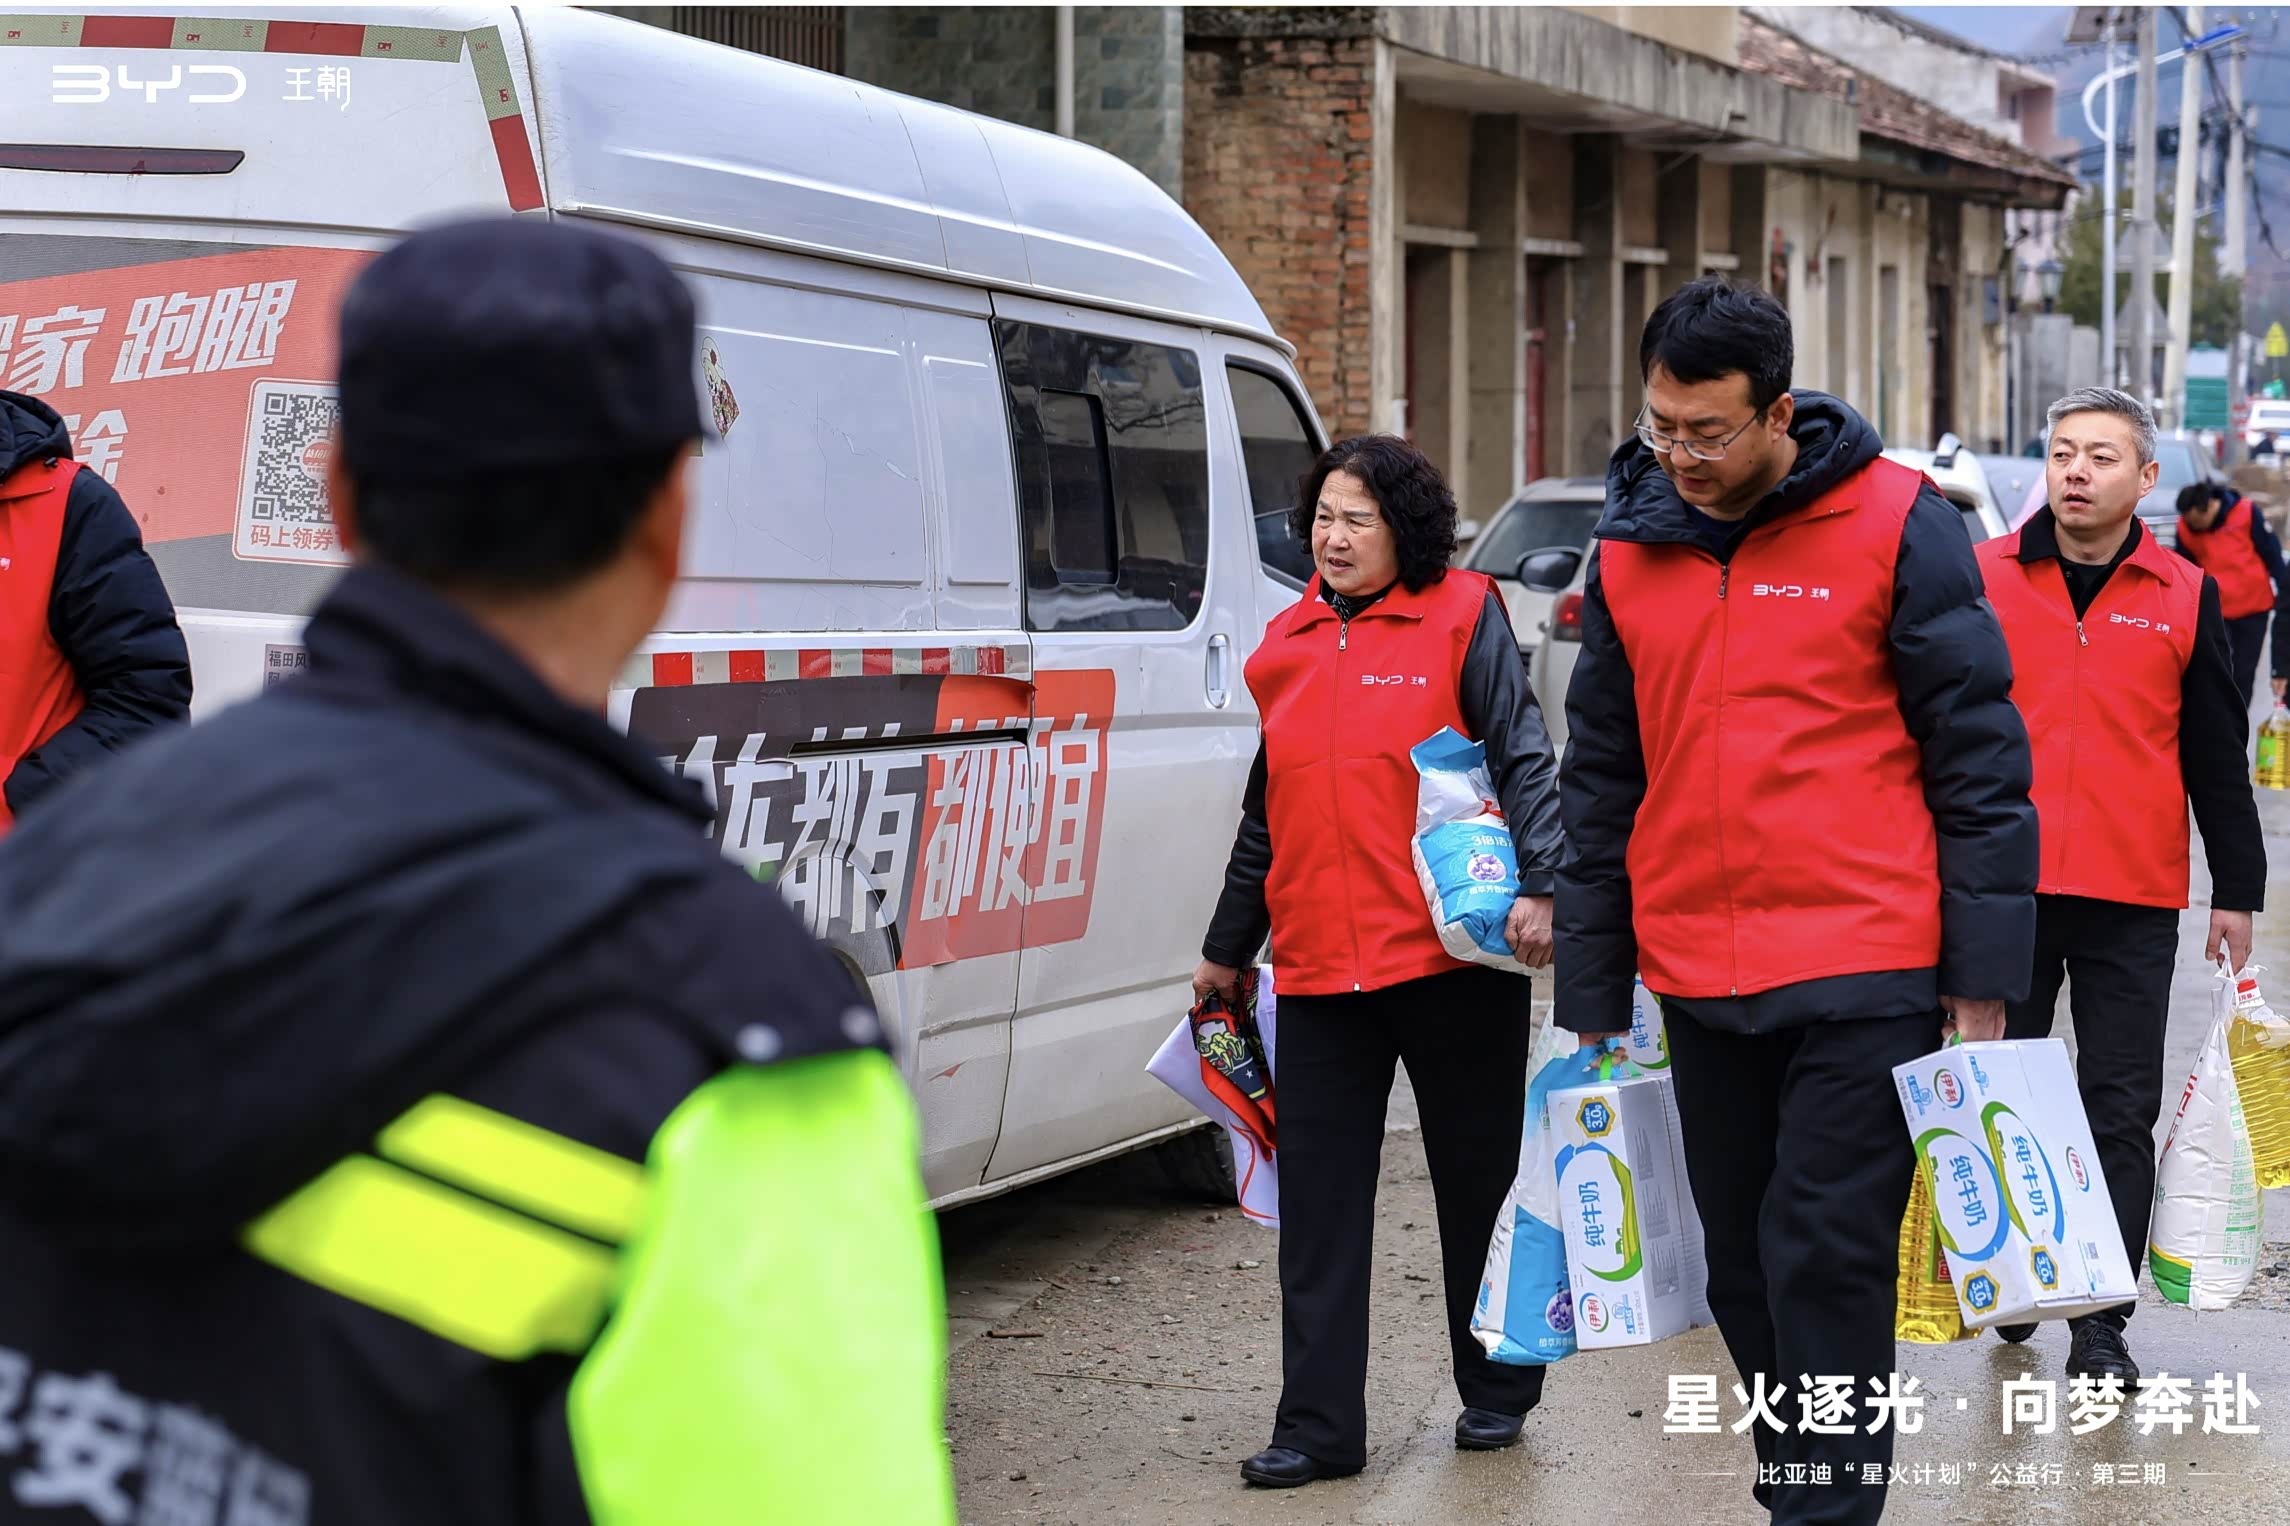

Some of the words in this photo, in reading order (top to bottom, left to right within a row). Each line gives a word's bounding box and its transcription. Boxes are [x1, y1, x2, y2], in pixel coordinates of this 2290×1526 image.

[110, 279, 298, 384] 跑腿
[250, 524, 350, 552] 码上领券
[1753, 584, 1803, 597] BYD
[2109, 612, 2149, 628] BYD
[1361, 674, 1404, 686] BYD
[1940, 1073, 1959, 1103] 伊利
[2010, 1135, 2049, 1217] 纯牛奶
[2069, 1152, 2086, 1186] 伊利
[1949, 1155, 1987, 1227] 纯牛奶
[1578, 1181, 1606, 1247] 纯牛奶
[1587, 1299, 1602, 1328] 伊利
